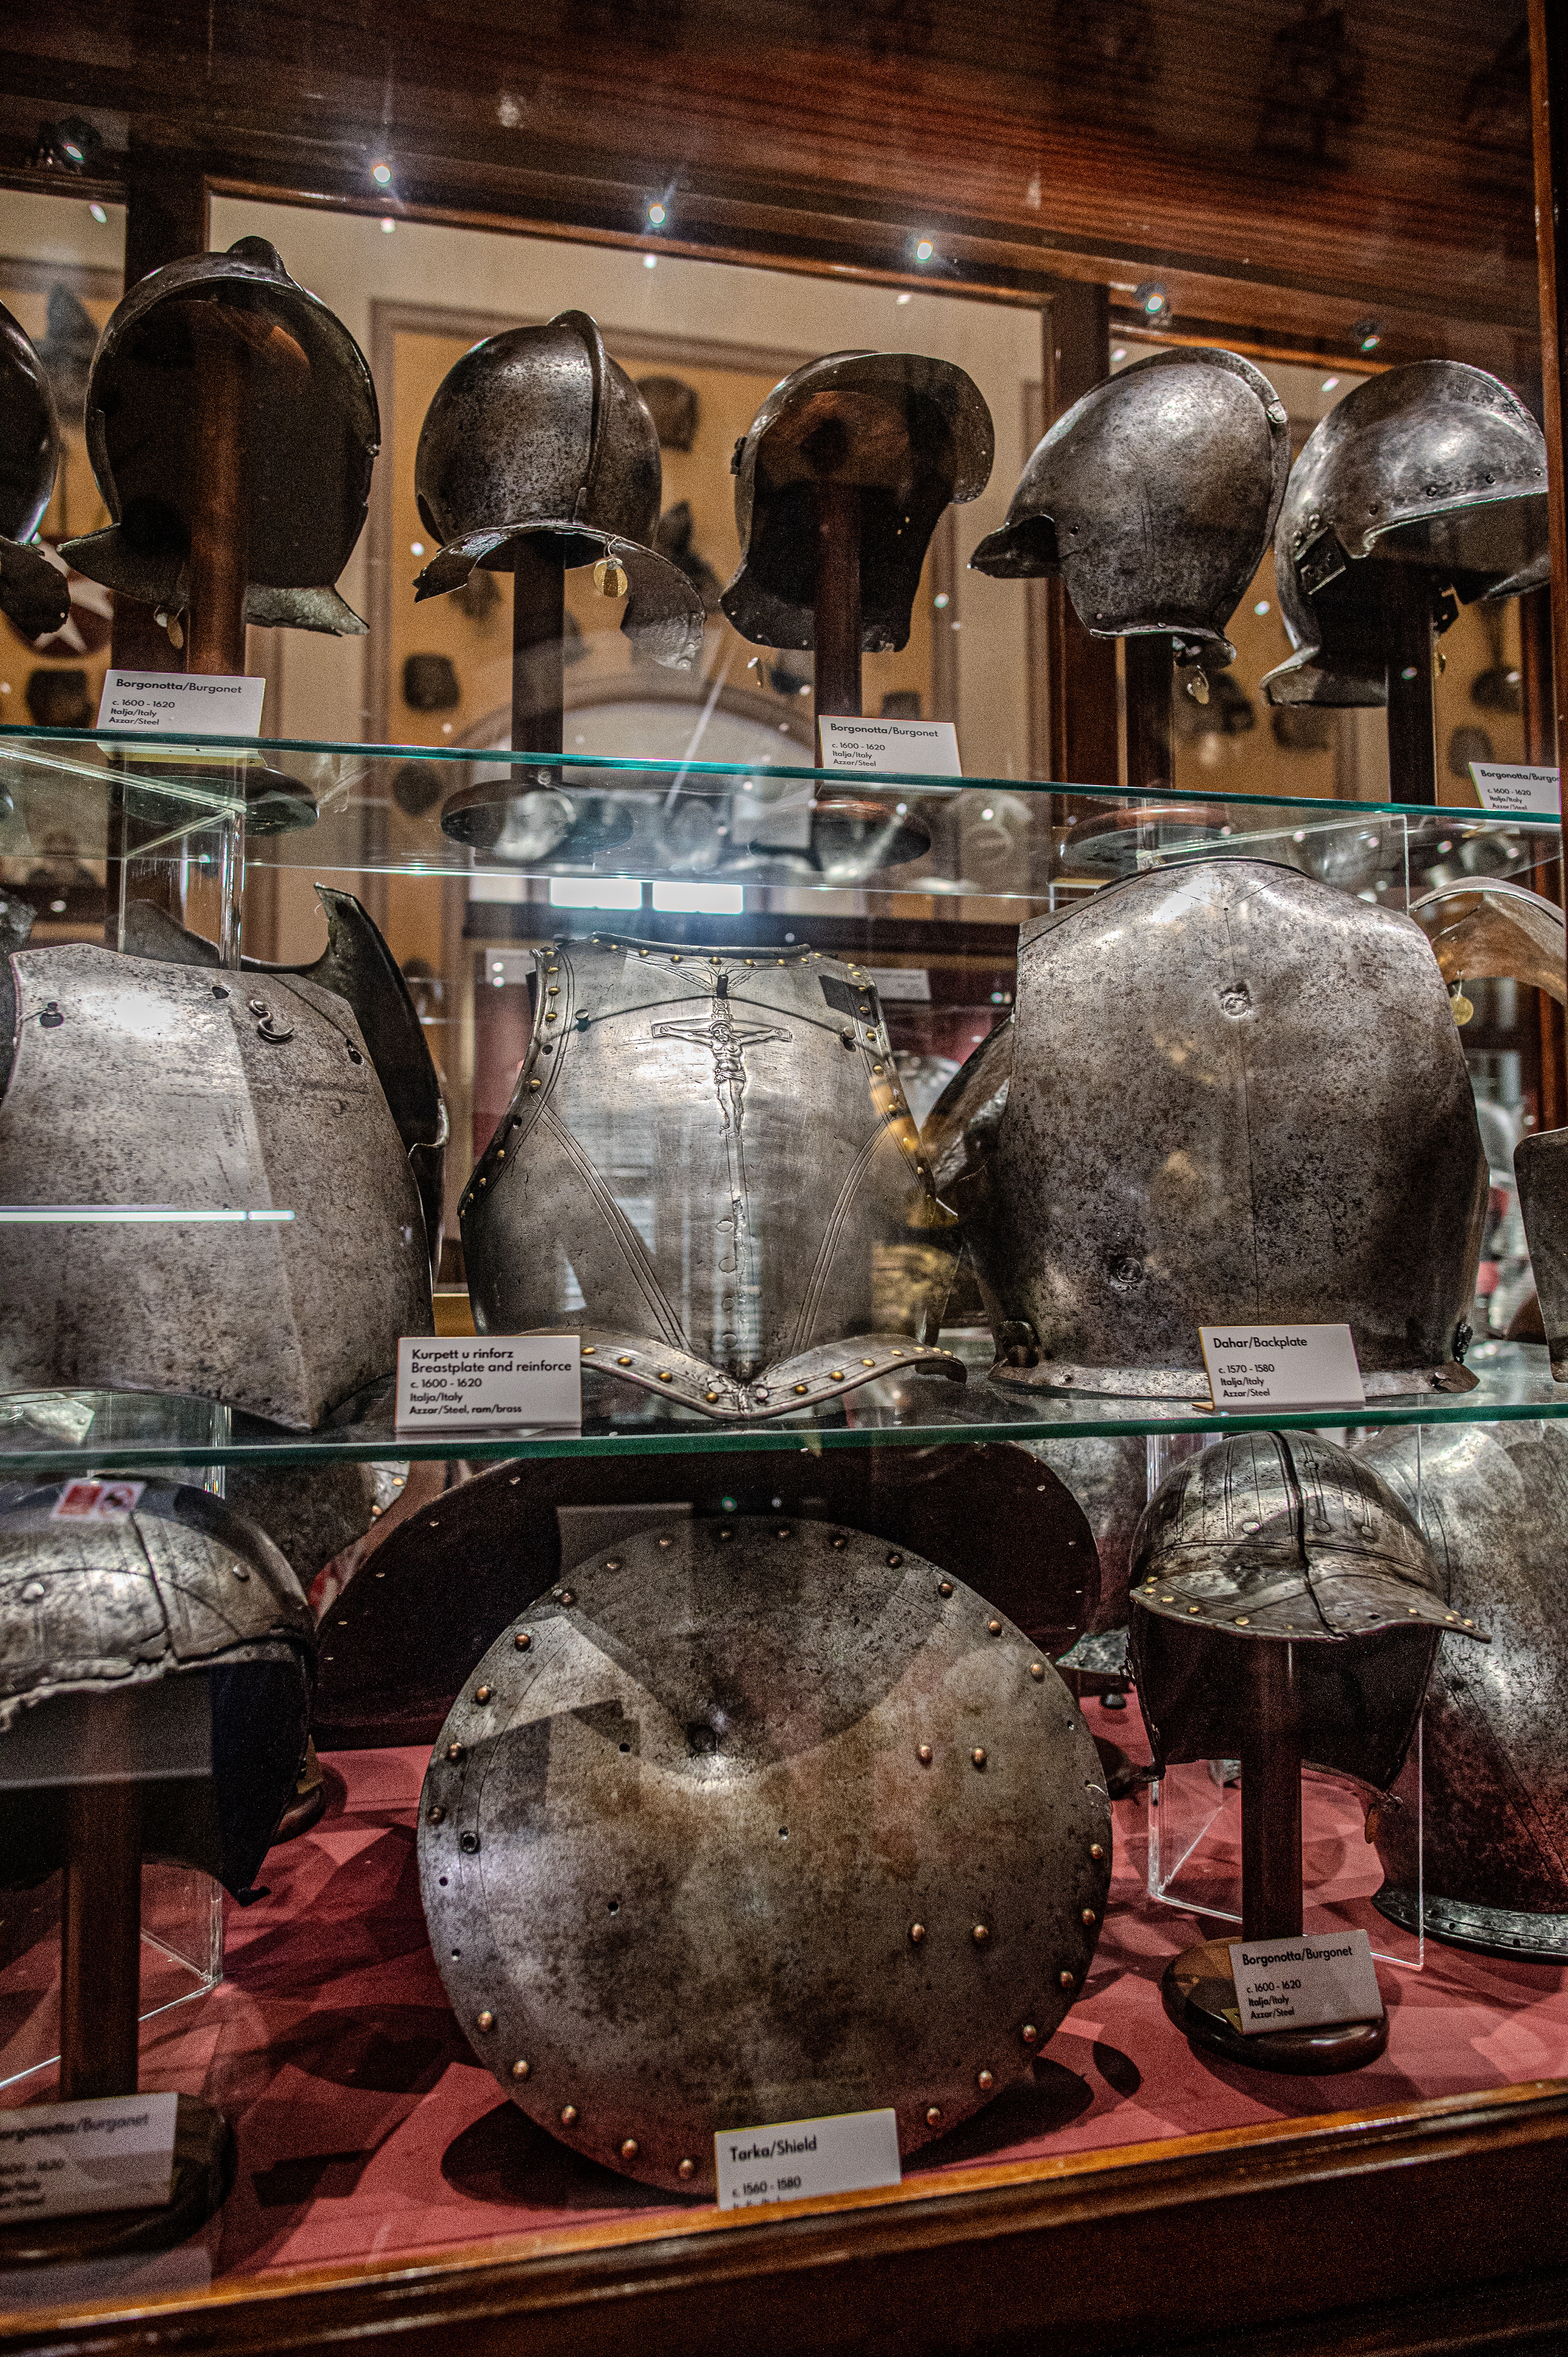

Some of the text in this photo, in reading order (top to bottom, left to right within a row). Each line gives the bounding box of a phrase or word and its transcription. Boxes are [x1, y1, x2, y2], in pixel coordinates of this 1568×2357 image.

[116, 679, 242, 694] Borgonotta/Burgonet
[153, 700, 176, 709] 1620
[110, 708, 157, 718] Italja/Italy
[109, 717, 160, 725] Azzar/Steel
[830, 723, 939, 738] Borgonotta/Burgonet
[832, 751, 872, 760] Italja/Italy
[833, 759, 876, 767] Azzar/Steel
[1490, 796, 1522, 804] Italja/Italy
[1213, 1336, 1308, 1349] Dahar/Backplate
[411, 1348, 514, 1361] Kurpett u rinforz
[411, 1359, 572, 1375] Breastplate and reinforce
[1227, 1365, 1247, 1373] 1570
[1255, 1364, 1275, 1372] 1580
[410, 1381, 418, 1389] c.
[421, 1379, 447, 1388] 1600
[457, 1378, 483, 1388] 1620
[1220, 1377, 1265, 1388] Italja/Italy
[409, 1392, 463, 1403] Italja/Italy
[1222, 1388, 1271, 1398] Azzar/Steel
[409, 1404, 523, 1415] Azzar/Steel, ram/brass
[1242, 1946, 1353, 1967] Borgonotta/Burgonet
[1254, 1982, 1275, 1992] 1600
[1281, 1979, 1301, 1990] 1620
[1248, 1994, 1290, 2008] Italja/Italy
[1250, 2006, 1295, 2020] Azzar/Steel
[729, 2134, 817, 2163] Tarka/Shield
[742, 2181, 767, 2196] 1560
[776, 2175, 802, 2191] 1580
